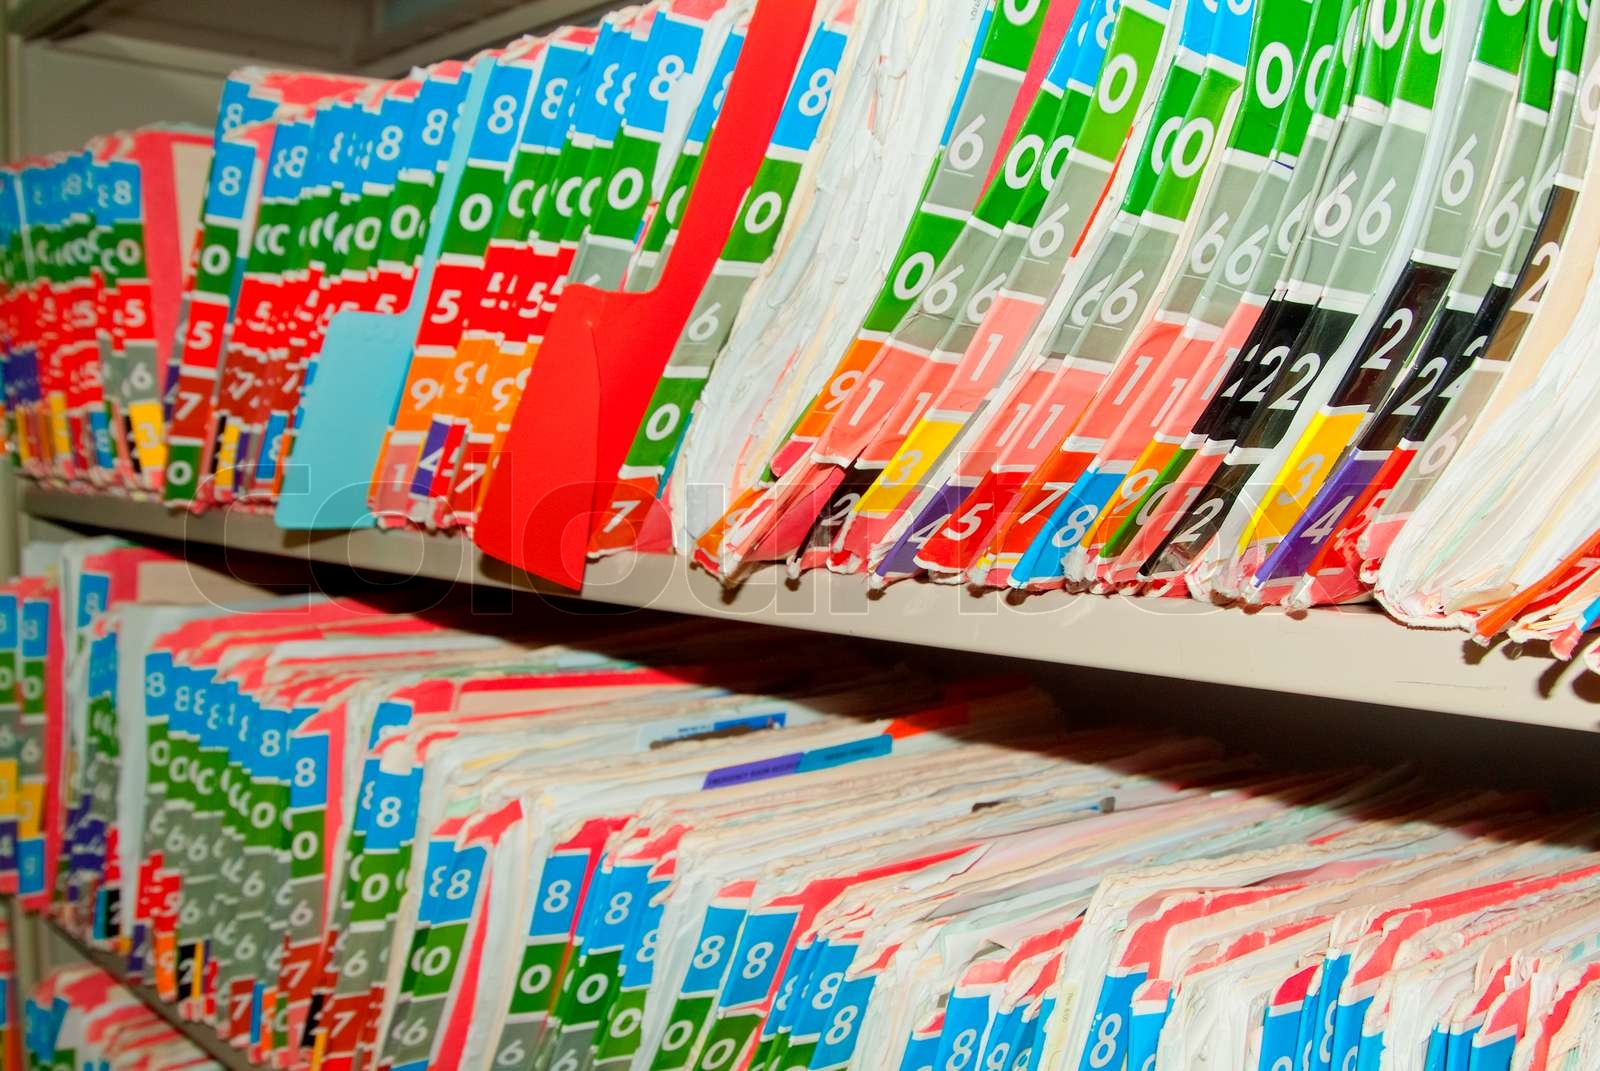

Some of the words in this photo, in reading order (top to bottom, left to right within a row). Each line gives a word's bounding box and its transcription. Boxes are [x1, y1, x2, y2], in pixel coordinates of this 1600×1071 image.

[649, 55, 685, 101] 8
[798, 67, 837, 116] 8
[1098, 53, 1138, 114] 0
[1256, 41, 1293, 109] 0
[422, 108, 448, 145] 8
[487, 95, 517, 134] 8
[376, 125, 403, 160] 8
[949, 114, 986, 170] 6
[1170, 117, 1214, 178] 0
[1004, 134, 1045, 189] 0
[1441, 134, 1478, 206] 6
[113, 180, 131, 204] 8
[219, 166, 241, 195] 8
[607, 167, 644, 210] 0
[391, 204, 420, 240] 0
[459, 193, 493, 232] 0
[744, 191, 782, 234] 0
[1314, 169, 1358, 238] 6
[1357, 176, 1397, 246] 6
[1485, 176, 1525, 249] 6
[354, 216, 382, 250] 0
[1028, 202, 1070, 258] 6
[1191, 211, 1229, 274] 6
[117, 239, 141, 264] 0
[202, 245, 230, 275] 0
[1225, 224, 1270, 285] 6
[893, 251, 935, 300] 0
[922, 264, 965, 315] 6
[1510, 241, 1559, 315] 2
[125, 299, 145, 327] 5
[430, 289, 462, 324] 5
[1100, 270, 1145, 325] 6
[188, 321, 214, 349] 5
[688, 302, 721, 341] 6
[1360, 307, 1413, 369] 2
[969, 333, 1003, 381] 1
[1239, 345, 1291, 402] 2
[130, 362, 153, 390] 6
[411, 378, 440, 410] 9
[1112, 355, 1153, 405] 1
[1267, 352, 1321, 411] 2
[1392, 356, 1448, 416] 2
[176, 392, 203, 420] 7
[848, 379, 885, 426] 1
[897, 392, 933, 435] 1
[1150, 377, 1188, 427] 1
[646, 403, 681, 441] 0
[995, 403, 1032, 447] 1
[1027, 404, 1066, 449] 1
[1419, 415, 1467, 476] 6
[167, 461, 192, 485] 0
[392, 463, 408, 492] 1
[454, 463, 487, 493] 7
[880, 450, 923, 486] 3
[1277, 454, 1325, 506] 3
[1017, 482, 1076, 524] 7
[1113, 469, 1158, 513] 9
[603, 501, 641, 533] 7
[942, 503, 993, 540] 5
[1052, 504, 1098, 548] 8
[1172, 497, 1224, 544] 2
[1300, 496, 1354, 544] 4
[23, 676, 42, 699] 0
[147, 672, 166, 697] 8
[175, 686, 190, 711] 8
[22, 737, 42, 763] 6
[151, 741, 170, 766] 0
[260, 729, 280, 756] 8
[294, 757, 316, 787] 8
[251, 802, 276, 828] 0
[376, 796, 401, 828] 8
[166, 827, 186, 851] 6
[188, 838, 209, 861] 6
[292, 831, 318, 860] 0
[243, 871, 265, 897] 6
[362, 873, 389, 902] 0
[446, 869, 471, 900] 8
[543, 880, 571, 913] 8
[181, 900, 200, 924] 6
[290, 900, 313, 927] 6
[604, 891, 633, 925] 8
[236, 937, 257, 961] 6
[343, 950, 368, 977] 6
[422, 946, 451, 976] 0
[693, 935, 725, 969] 8
[743, 942, 774, 979] 8
[520, 964, 552, 994] 0
[576, 973, 608, 1004] 0
[812, 972, 844, 1009] 8
[401, 1018, 428, 1046] 6
[610, 1007, 641, 1038] 0
[661, 1020, 693, 1051] 0
[824, 1006, 858, 1045] 8
[1089, 1013, 1122, 1069] 8
[498, 1040, 524, 1066] 6
[701, 1038, 735, 1070] 0
[945, 1028, 977, 1071] 8
